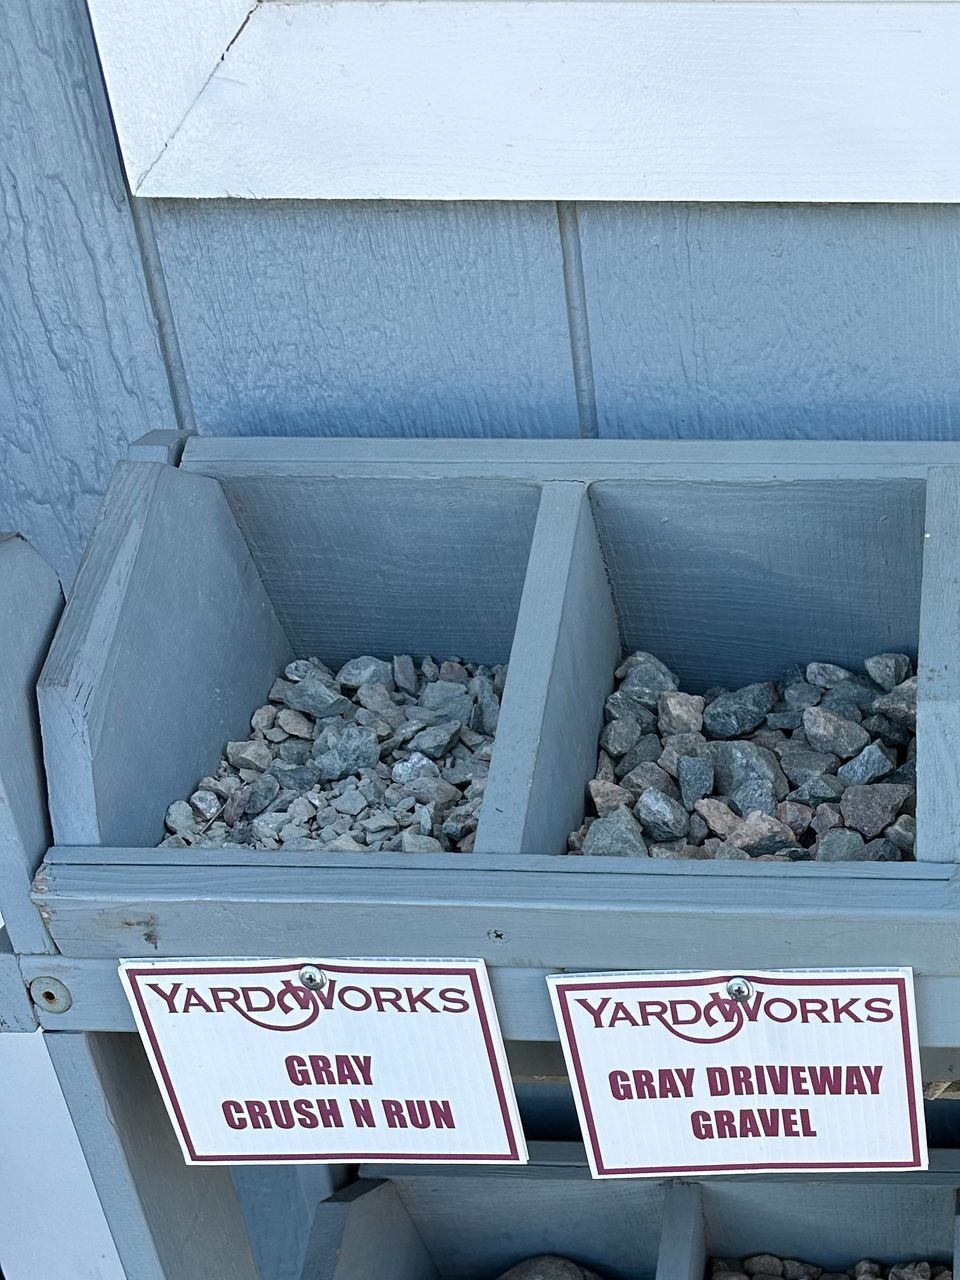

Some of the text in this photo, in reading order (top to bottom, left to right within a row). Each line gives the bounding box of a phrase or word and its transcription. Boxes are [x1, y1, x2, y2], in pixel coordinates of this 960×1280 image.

[285, 1055, 372, 1086] GRAY
[609, 1066, 882, 1100] GRAY DRIVEWAY
[222, 1099, 455, 1130] CRUSH N RUN
[691, 1109, 816, 1139] GRAVEL
